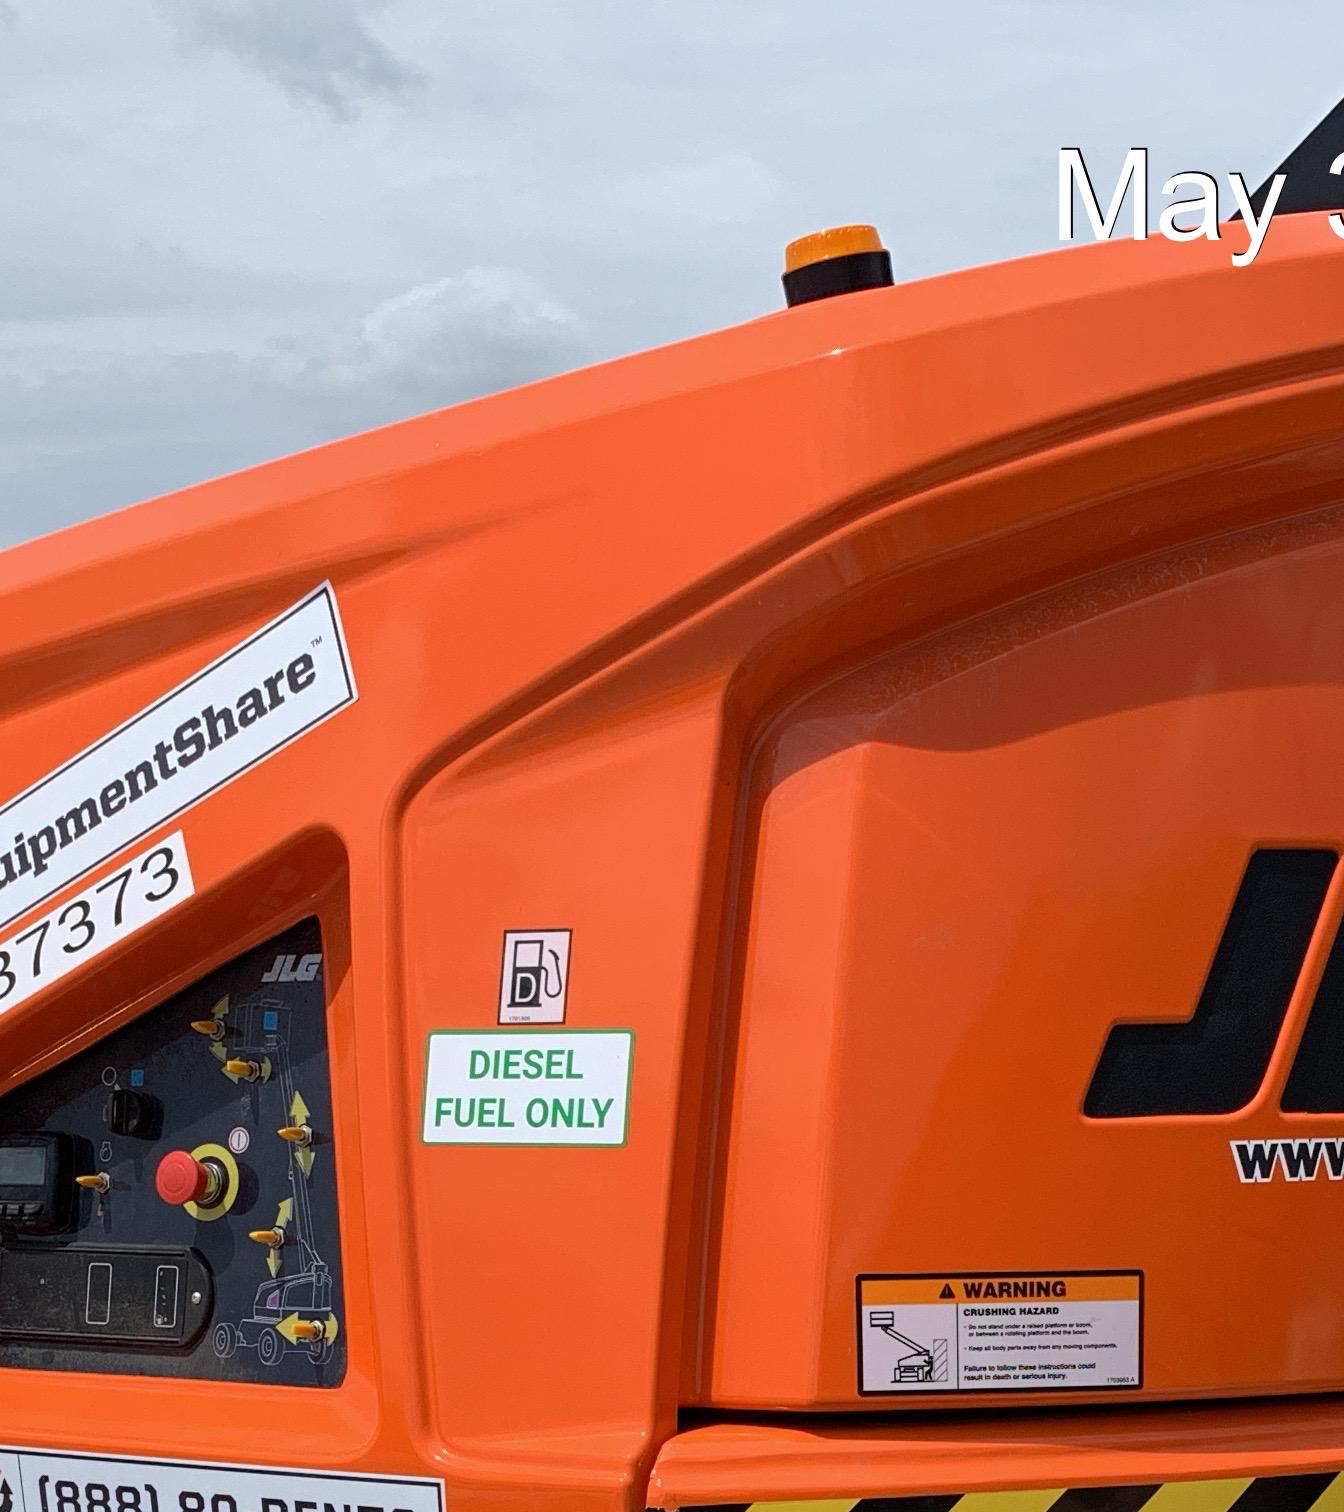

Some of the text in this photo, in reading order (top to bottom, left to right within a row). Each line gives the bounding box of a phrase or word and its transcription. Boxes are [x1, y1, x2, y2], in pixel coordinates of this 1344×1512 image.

[262, 953, 322, 983] JLG
[469, 1049, 584, 1080] DIESEL
[434, 1097, 615, 1129] FUEL ONLY
[963, 1280, 1067, 1299] WARNING
[963, 1306, 1059, 1317] CRUSHING HAZARD
